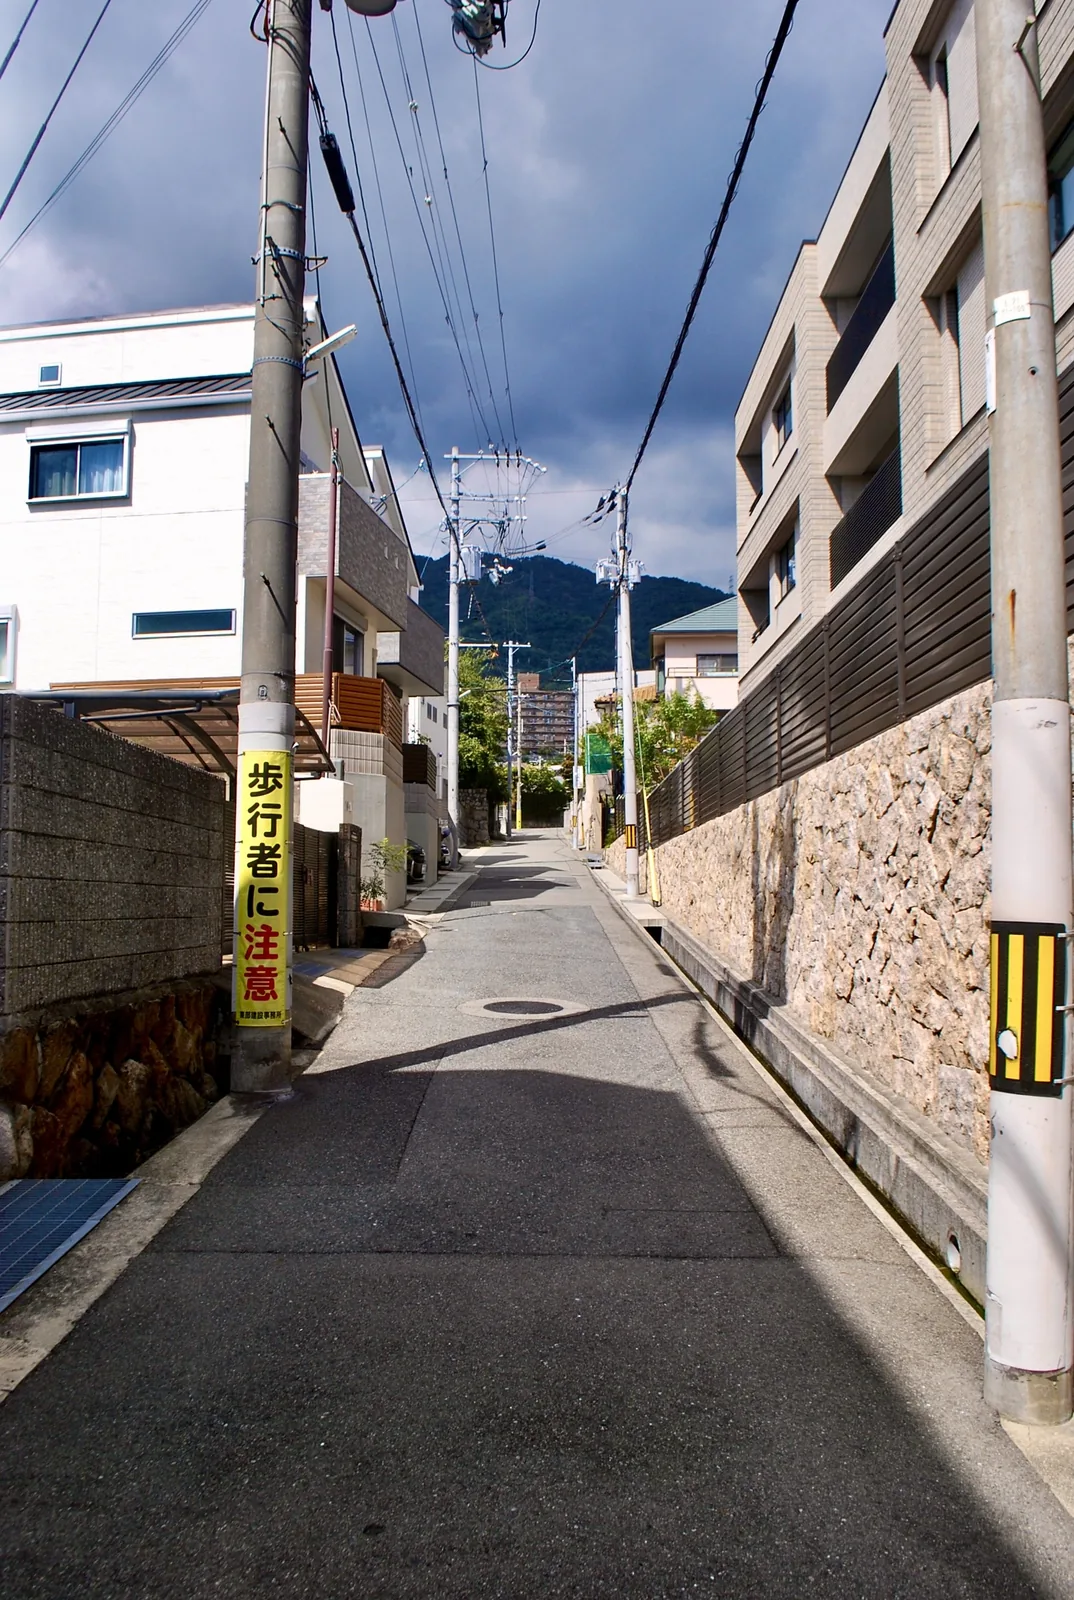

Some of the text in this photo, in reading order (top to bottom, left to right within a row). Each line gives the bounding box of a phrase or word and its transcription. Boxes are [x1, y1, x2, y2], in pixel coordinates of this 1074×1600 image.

[244, 762, 283, 1001] 歩行者に注意
